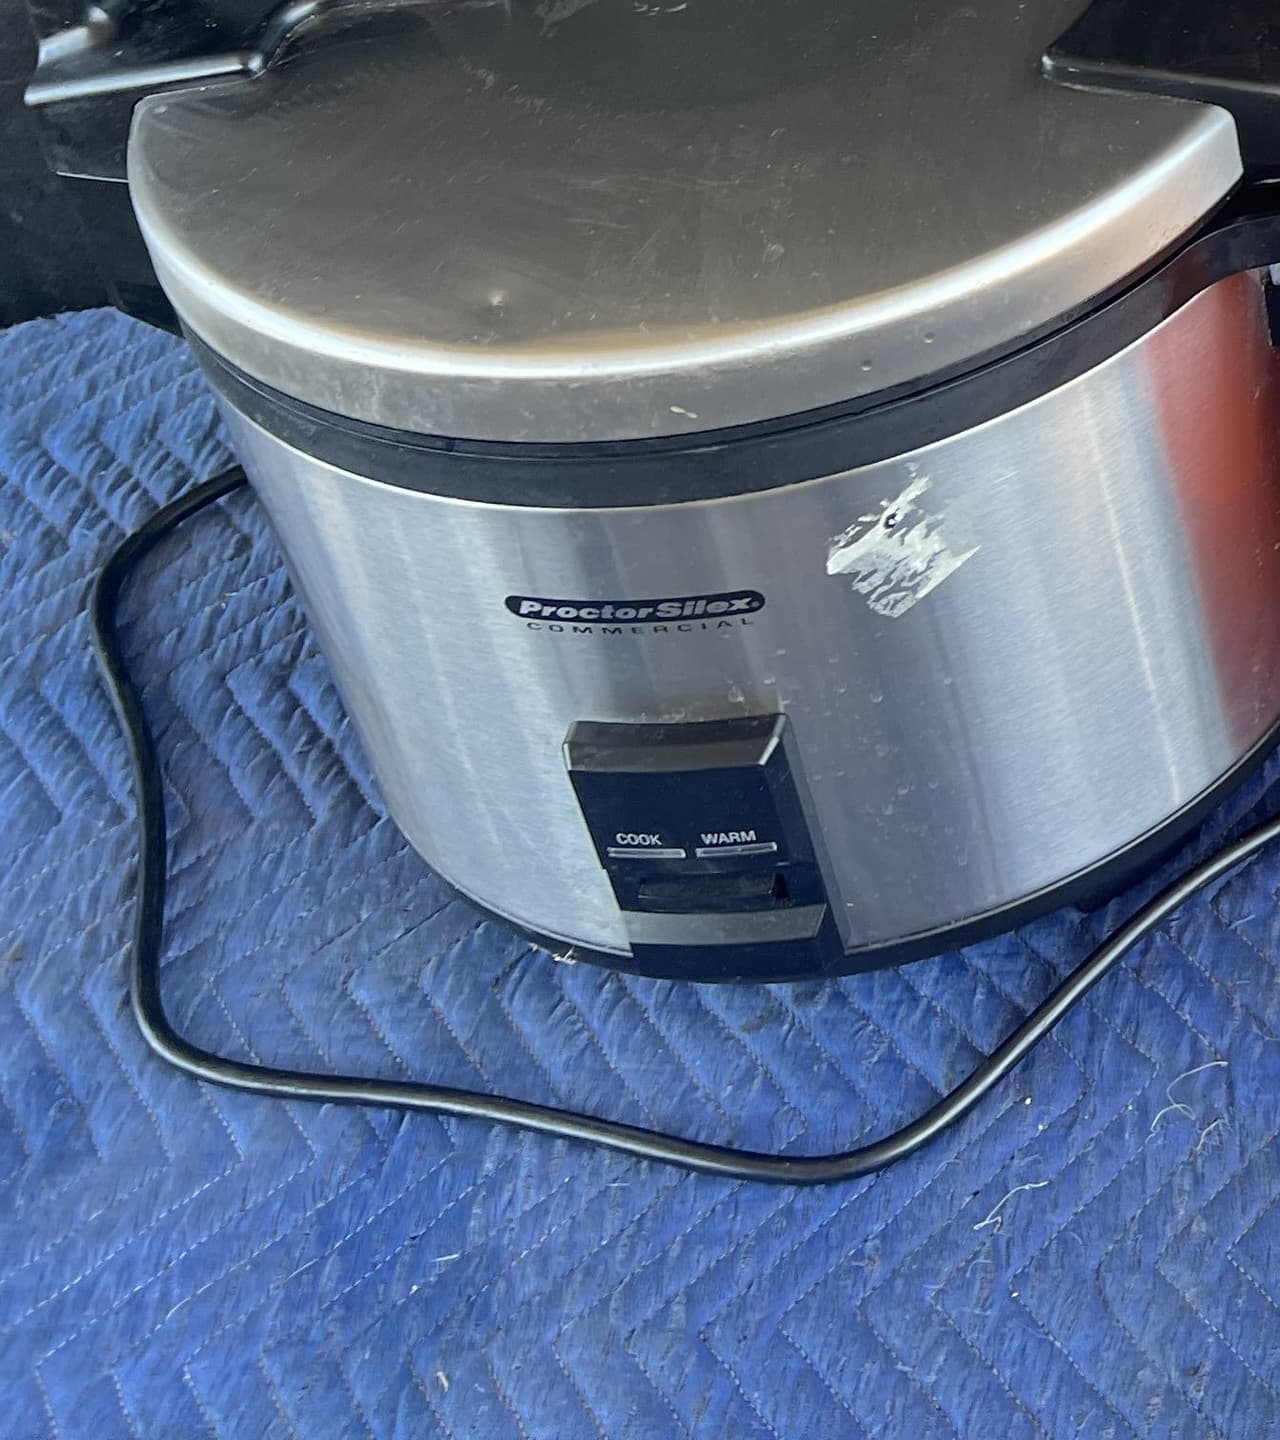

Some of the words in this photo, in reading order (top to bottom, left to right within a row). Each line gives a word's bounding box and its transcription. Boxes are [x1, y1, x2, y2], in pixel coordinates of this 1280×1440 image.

[527, 617, 755, 635] COMMERCIAL
[616, 832, 662, 846] COOK
[700, 830, 757, 845] WARM
